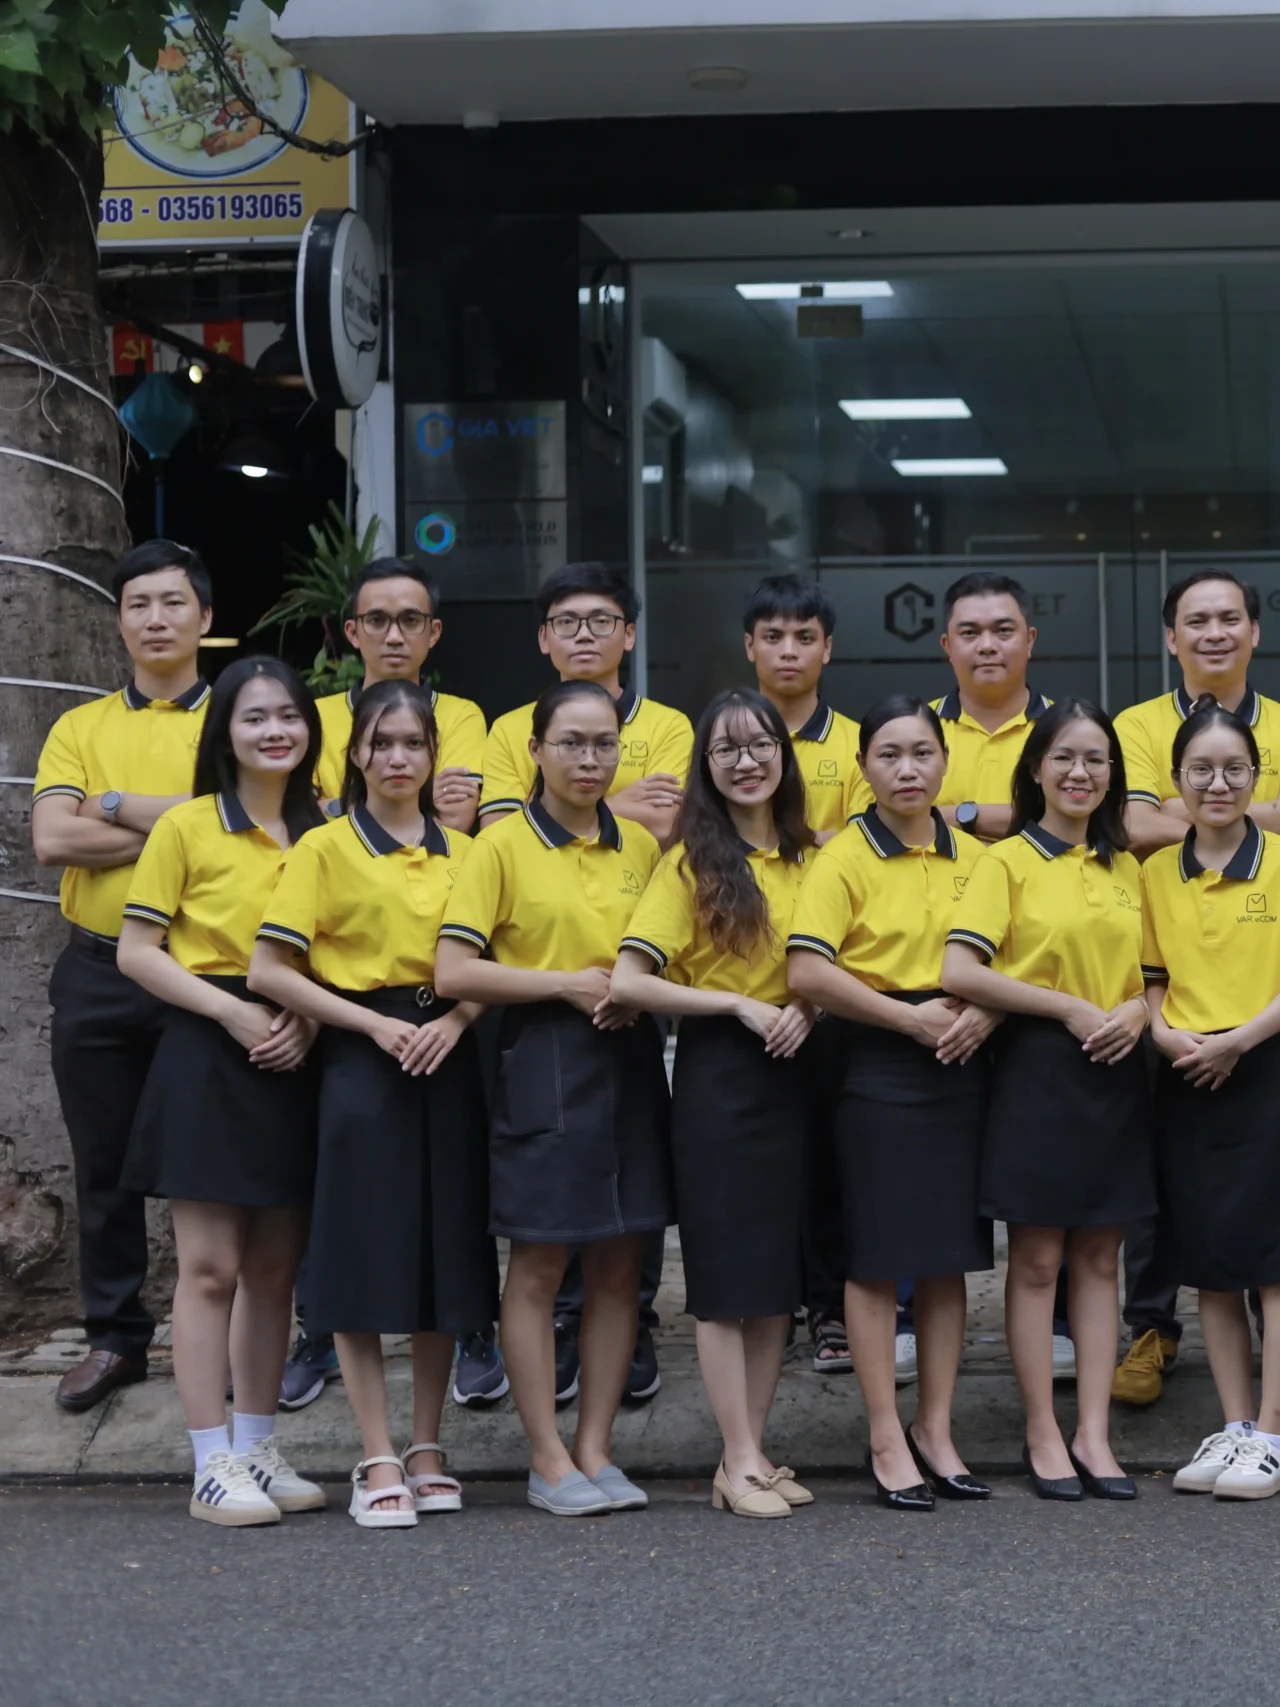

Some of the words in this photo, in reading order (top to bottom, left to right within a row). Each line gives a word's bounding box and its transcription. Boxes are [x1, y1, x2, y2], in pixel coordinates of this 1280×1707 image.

[159, 193, 302, 221] 0356193065
[1033, 592, 1066, 616] ET
[1236, 915, 1253, 923] VAR
